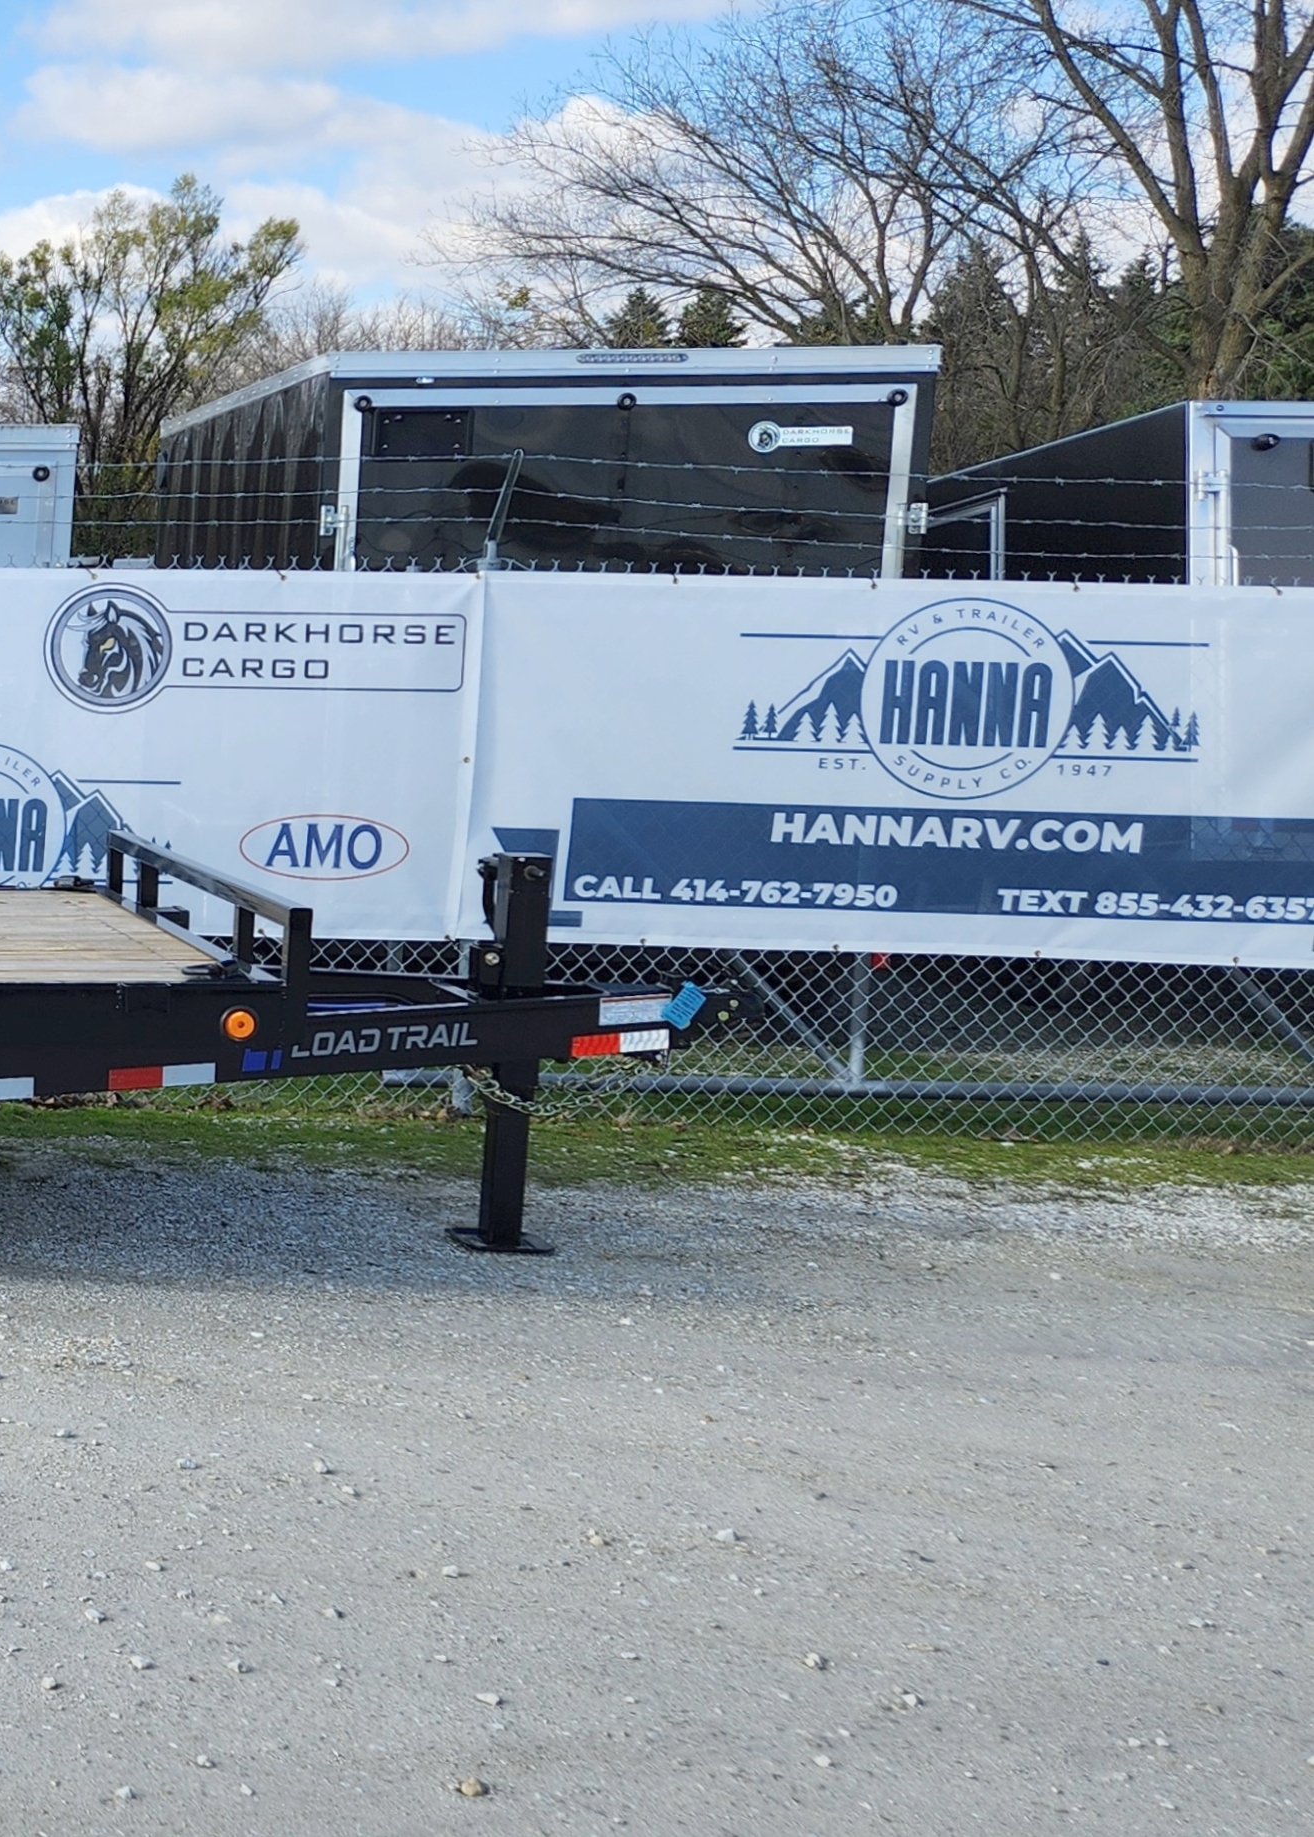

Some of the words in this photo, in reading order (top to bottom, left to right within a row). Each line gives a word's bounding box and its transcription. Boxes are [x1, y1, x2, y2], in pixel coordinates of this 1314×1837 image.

[782, 428, 850, 436] DARKHORSE
[184, 621, 456, 645] DARKHORSE
[897, 624, 920, 646] RV
[932, 613, 943, 625] &
[956, 608, 1046, 648] TRAILER
[183, 657, 330, 679] CARGO
[879, 659, 1053, 748] HANNA
[818, 756, 866, 771] EST.
[894, 755, 982, 790] SUPPLY
[1000, 757, 1033, 780] CO.
[1056, 764, 1113, 777] 1947
[266, 823, 382, 871] AMO
[770, 812, 1144, 855] HANNARV.COM
[574, 874, 661, 900] CALL
[670, 878, 898, 908] 414-762-7950
[997, 888, 1088, 914] TEXT
[291, 1028, 381, 1058] LOAD
[387, 1022, 478, 1050] TRAIL
